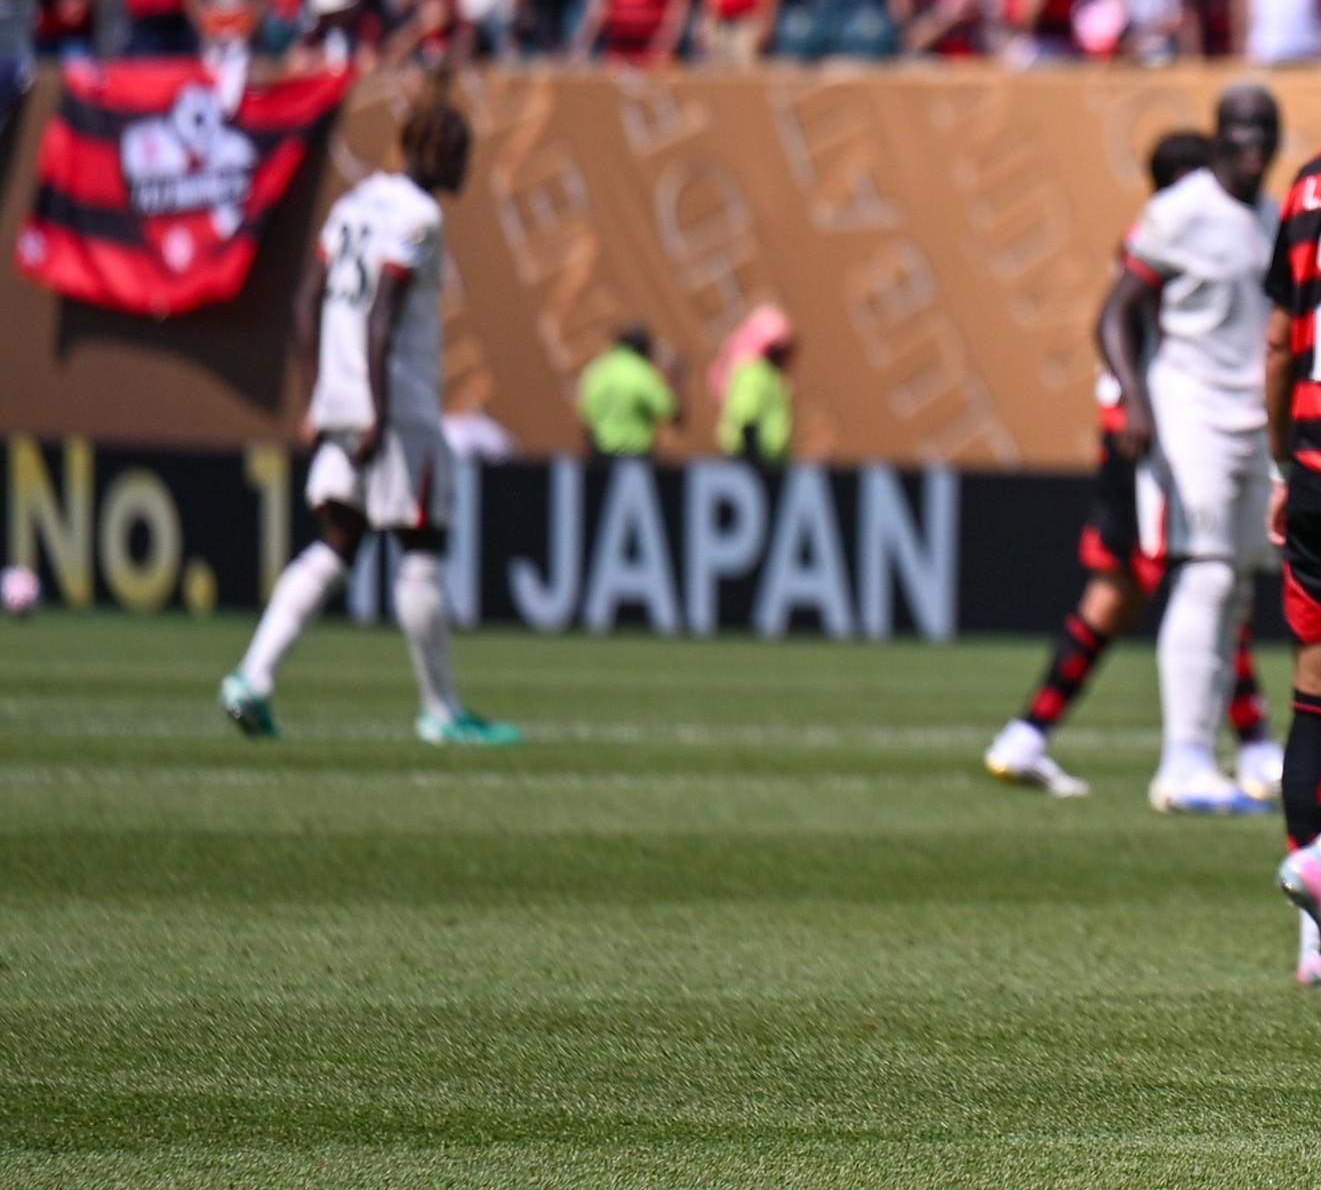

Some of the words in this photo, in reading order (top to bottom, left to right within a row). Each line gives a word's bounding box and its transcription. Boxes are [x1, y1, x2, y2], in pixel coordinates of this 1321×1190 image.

[9, 435, 217, 616] No.
[245, 442, 291, 608] 1
[508, 453, 959, 638] JAPAN
